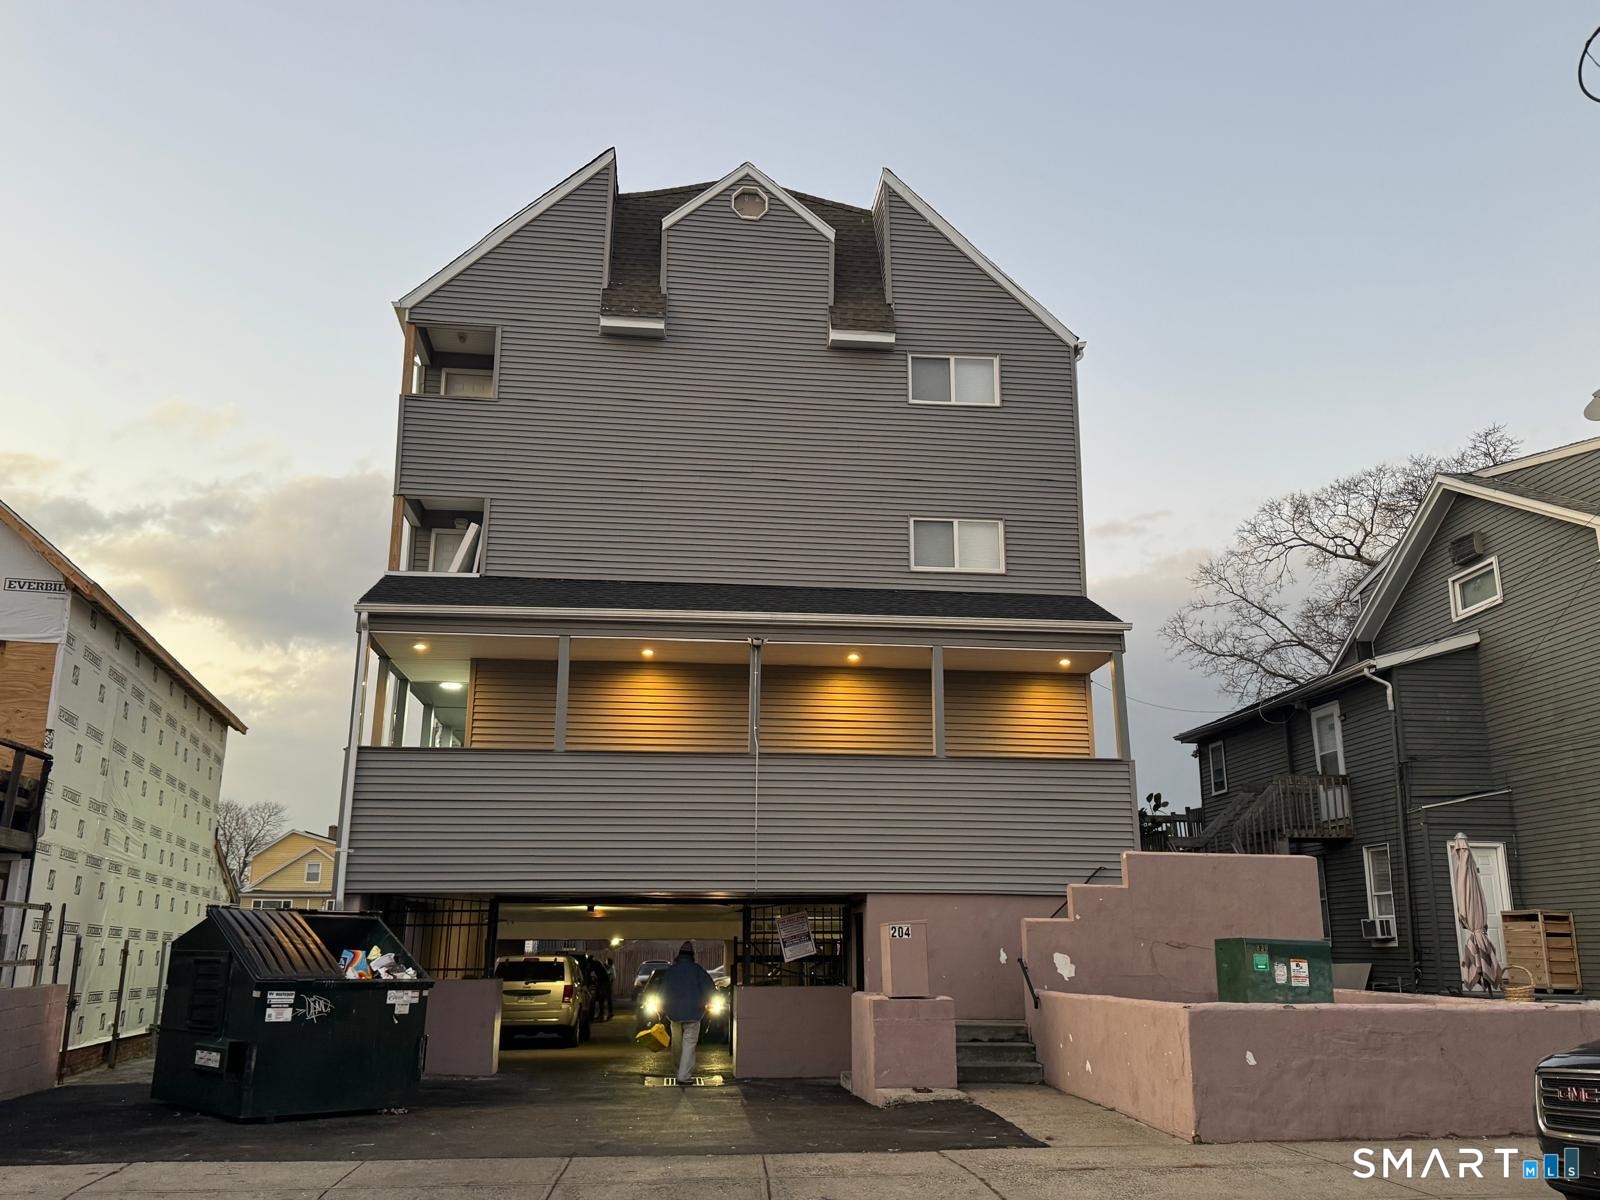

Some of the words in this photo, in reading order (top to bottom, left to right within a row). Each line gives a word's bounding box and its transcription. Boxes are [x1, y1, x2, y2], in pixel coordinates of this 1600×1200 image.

[8, 580, 66, 592] EVERBIL
[891, 926, 911, 938] 204
[1558, 1087, 1598, 1102] GMC
